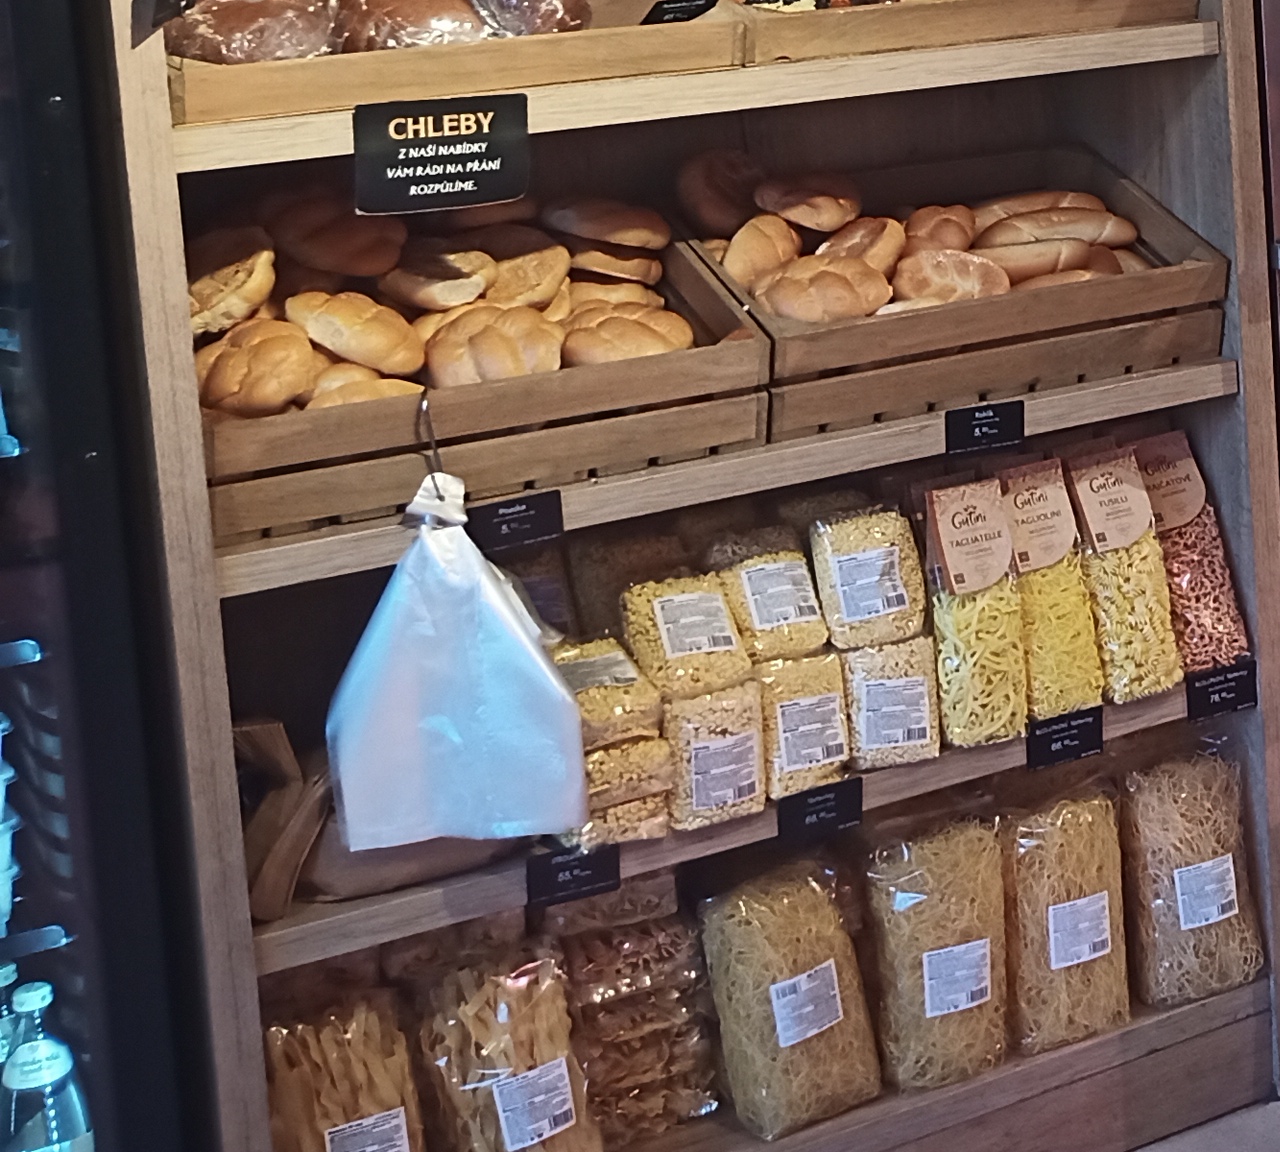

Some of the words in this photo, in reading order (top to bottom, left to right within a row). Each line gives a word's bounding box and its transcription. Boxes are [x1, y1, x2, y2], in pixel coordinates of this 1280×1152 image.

[388, 111, 495, 141] CHLEBY
[438, 141, 488, 157] NABÍDKY
[386, 164, 413, 180] VÁM
[415, 163, 444, 177] RÁDI
[445, 160, 464, 175] NA
[466, 157, 502, 173] PŘÁNÍ
